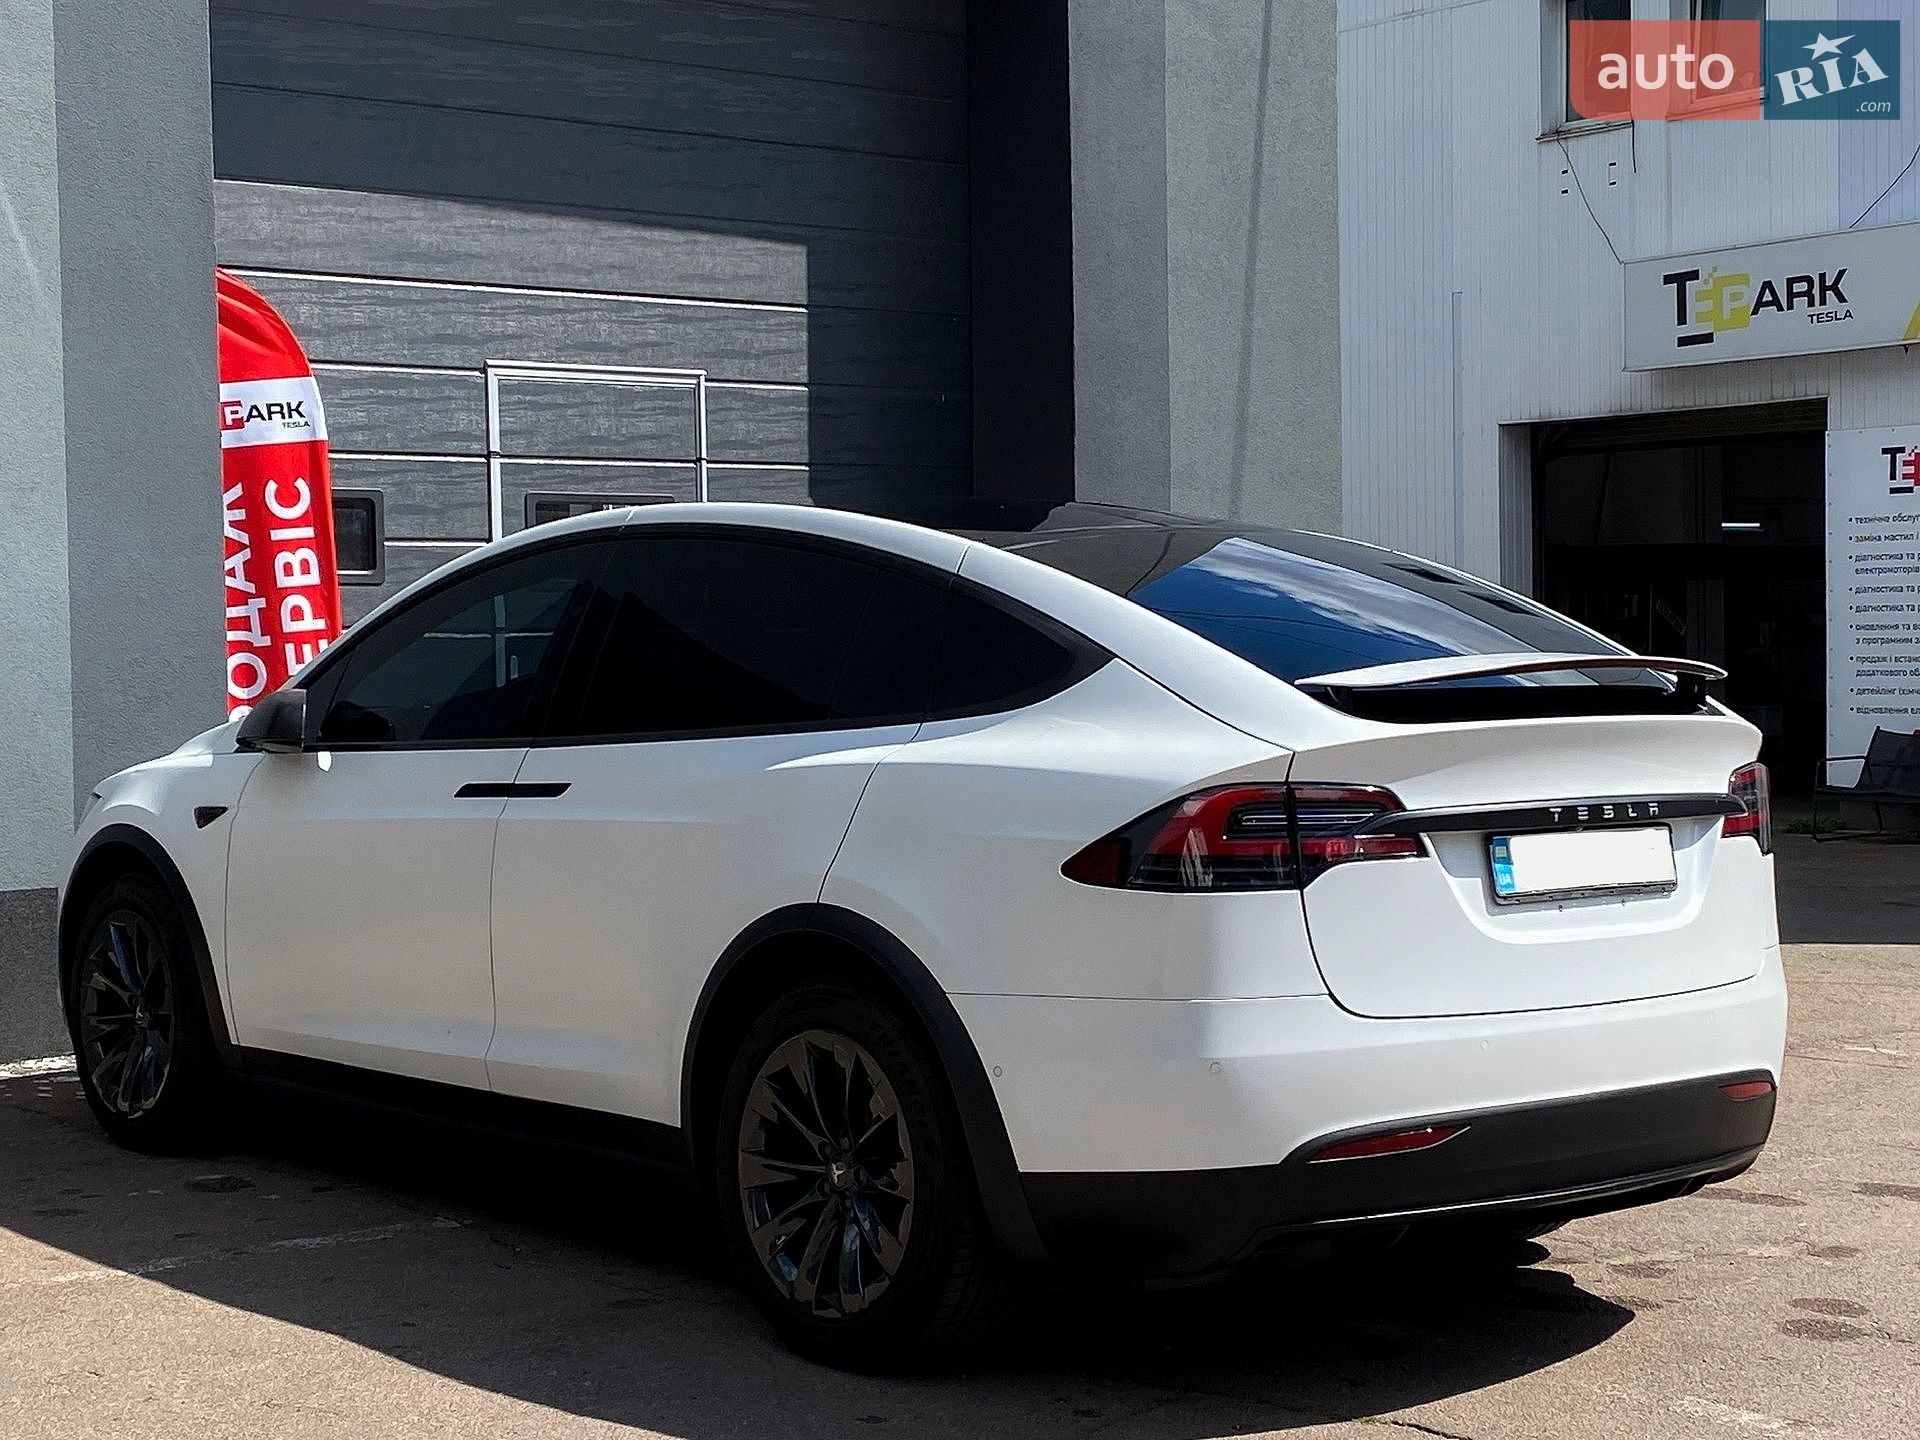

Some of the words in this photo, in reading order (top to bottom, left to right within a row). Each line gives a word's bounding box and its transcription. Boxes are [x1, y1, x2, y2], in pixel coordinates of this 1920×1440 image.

[1807, 309, 1854, 325] TESLA
[281, 420, 310, 429] TESLA
[1905, 552, 1915, 560] та
[264, 476, 331, 677] ЕРВІС
[1905, 585, 1915, 593] та
[222, 481, 272, 722] ОДАЖ
[1905, 604, 1915, 612] та
[1549, 802, 1660, 823] TESLA
